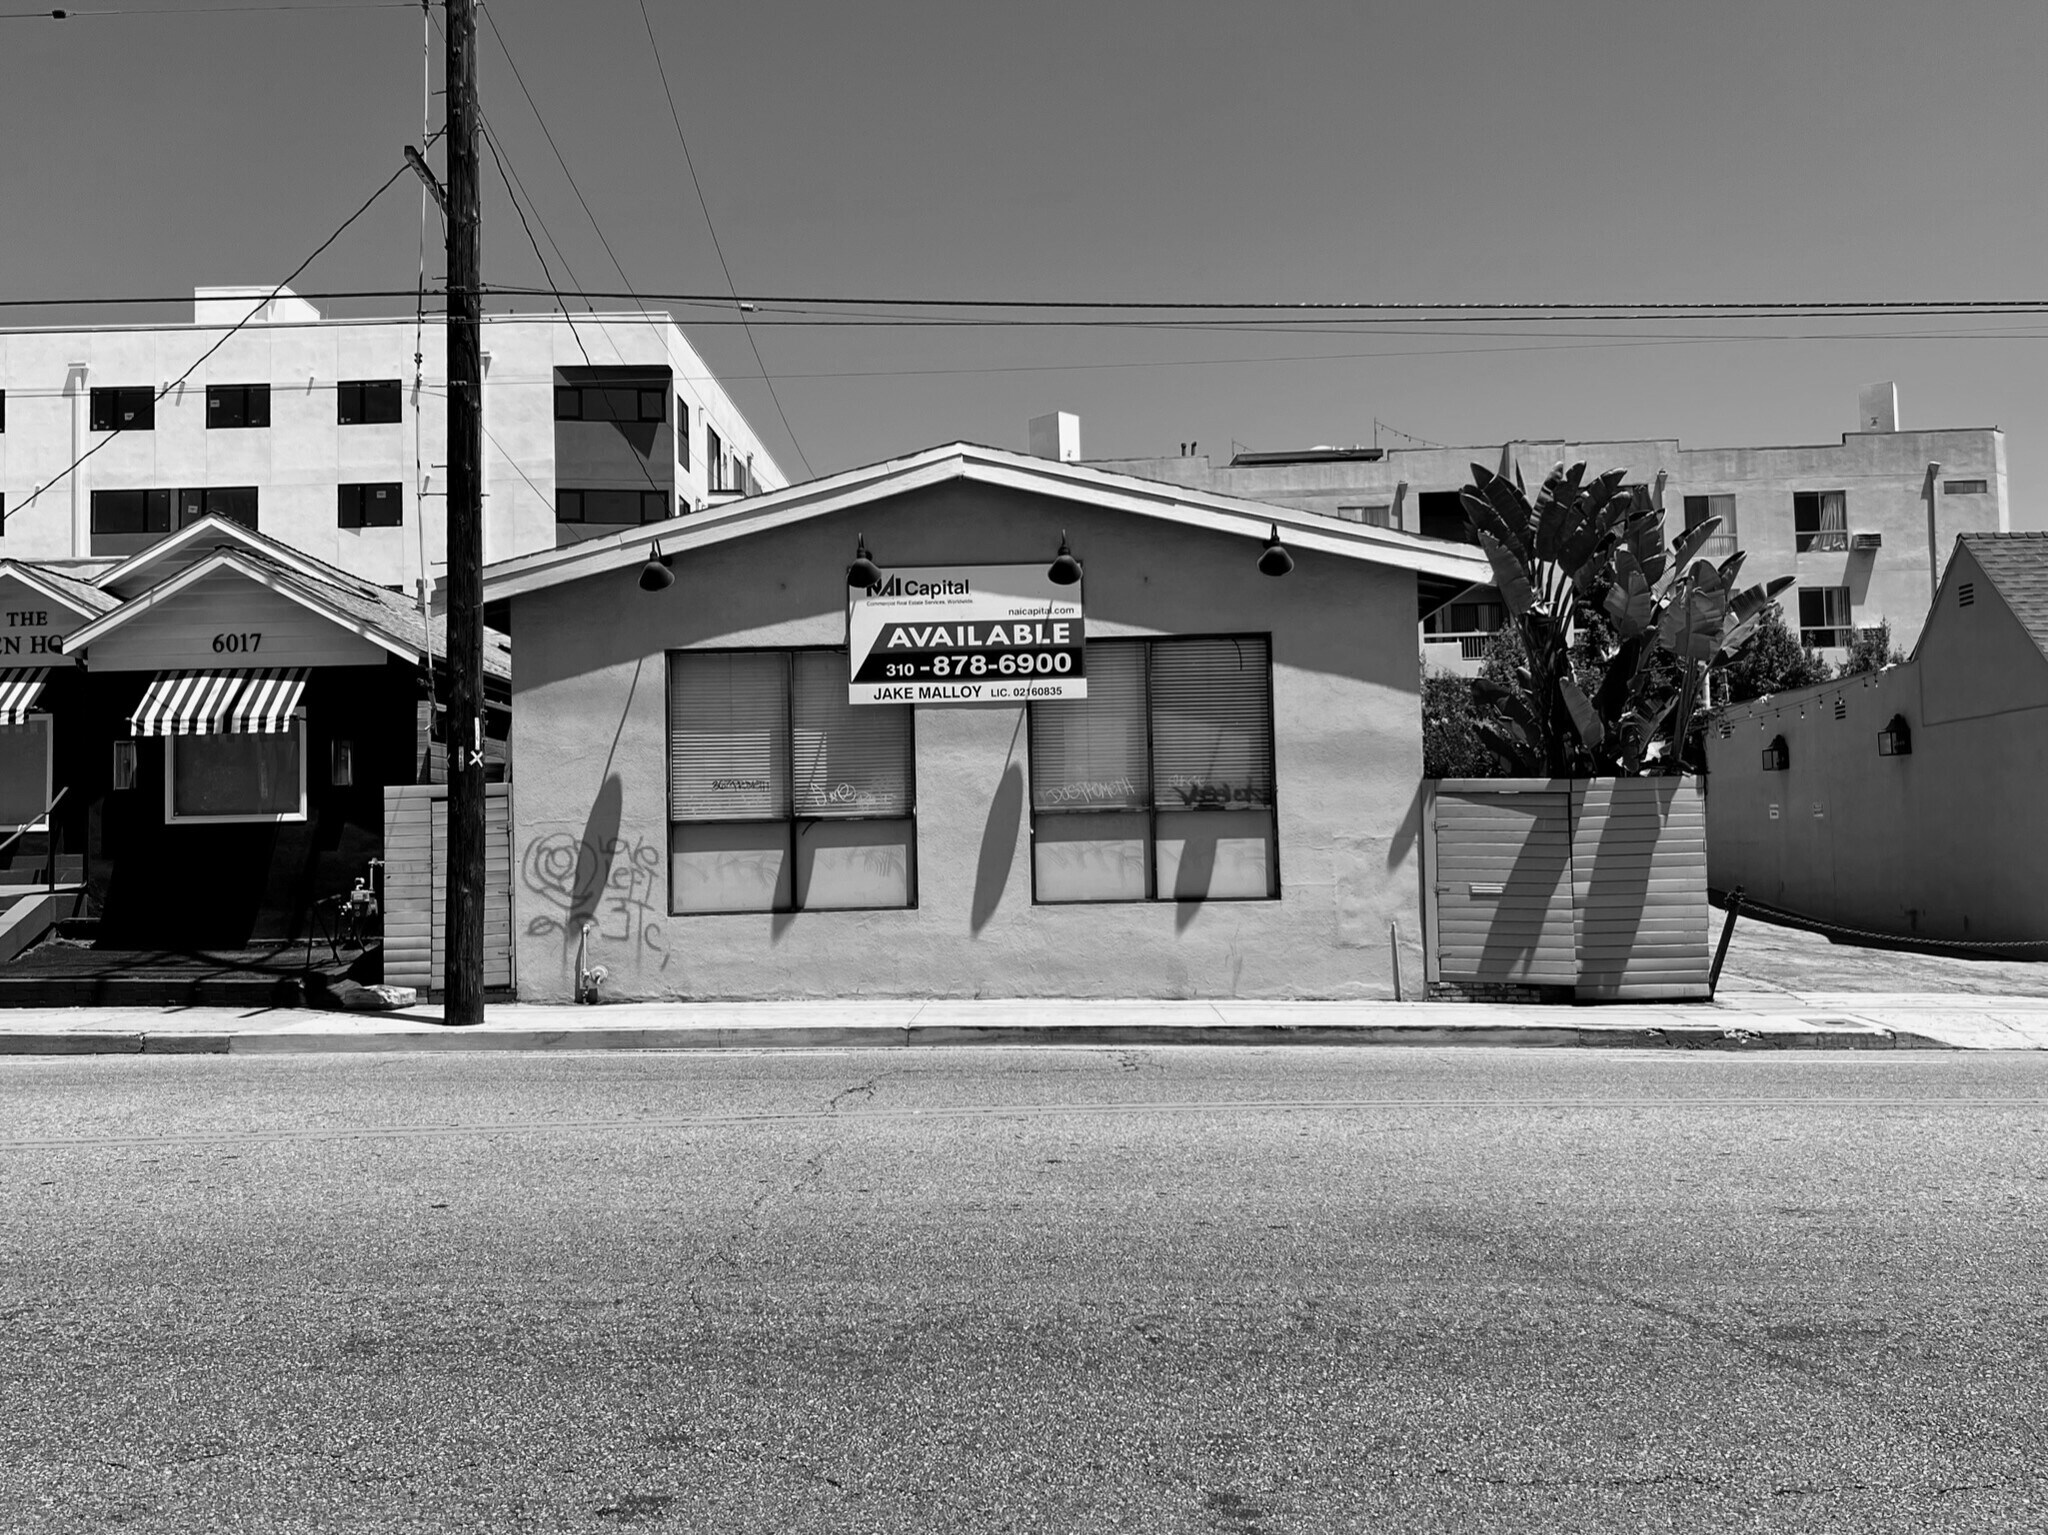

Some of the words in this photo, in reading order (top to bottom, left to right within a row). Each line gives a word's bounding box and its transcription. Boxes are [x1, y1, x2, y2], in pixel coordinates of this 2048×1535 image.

[904, 579, 970, 599] Capital
[6, 611, 48, 627] THE
[1008, 606, 1075, 617] naicapital.com
[212, 633, 261, 653] 6017
[887, 622, 1070, 648] AVAILABLE
[886, 663, 914, 677] 310
[874, 686, 914, 701] JAKE
[918, 685, 982, 700] MALLOY
[990, 687, 1011, 698] LIC.
[1013, 686, 1063, 698] 02160835
